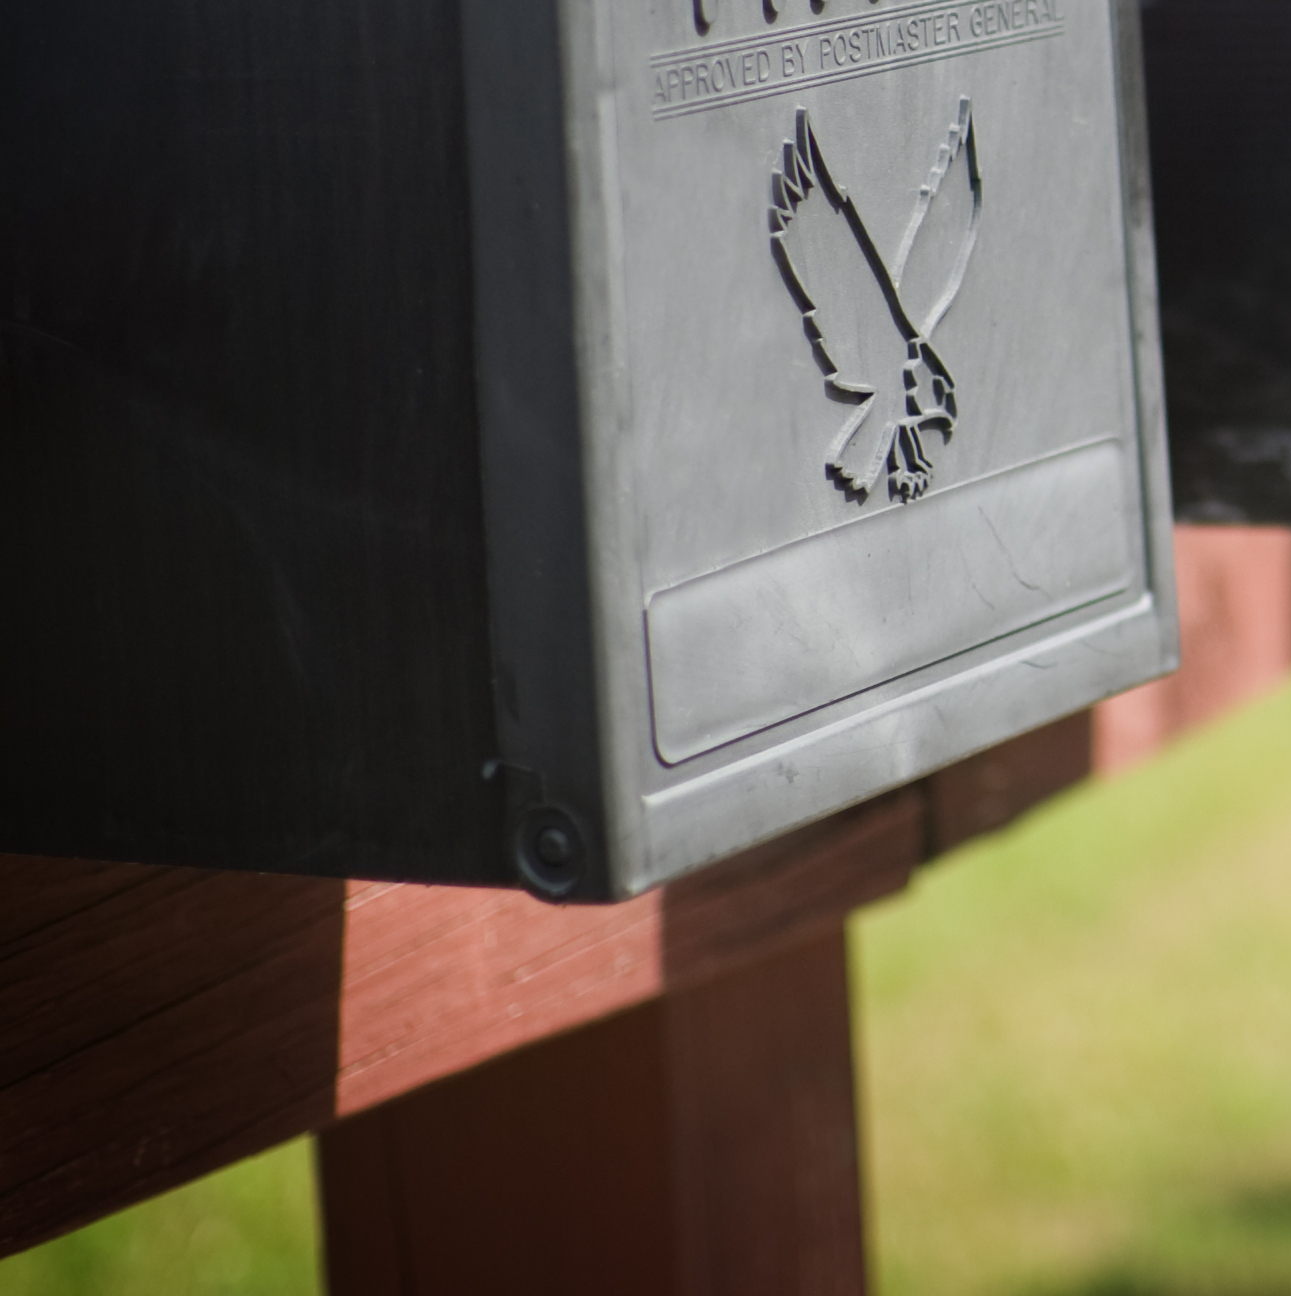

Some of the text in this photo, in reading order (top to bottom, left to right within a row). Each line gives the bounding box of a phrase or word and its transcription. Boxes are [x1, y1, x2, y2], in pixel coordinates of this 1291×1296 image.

[653, 50, 771, 103] APPROVED
[780, 41, 810, 80] BY
[819, 11, 962, 70] POSTMASTER
